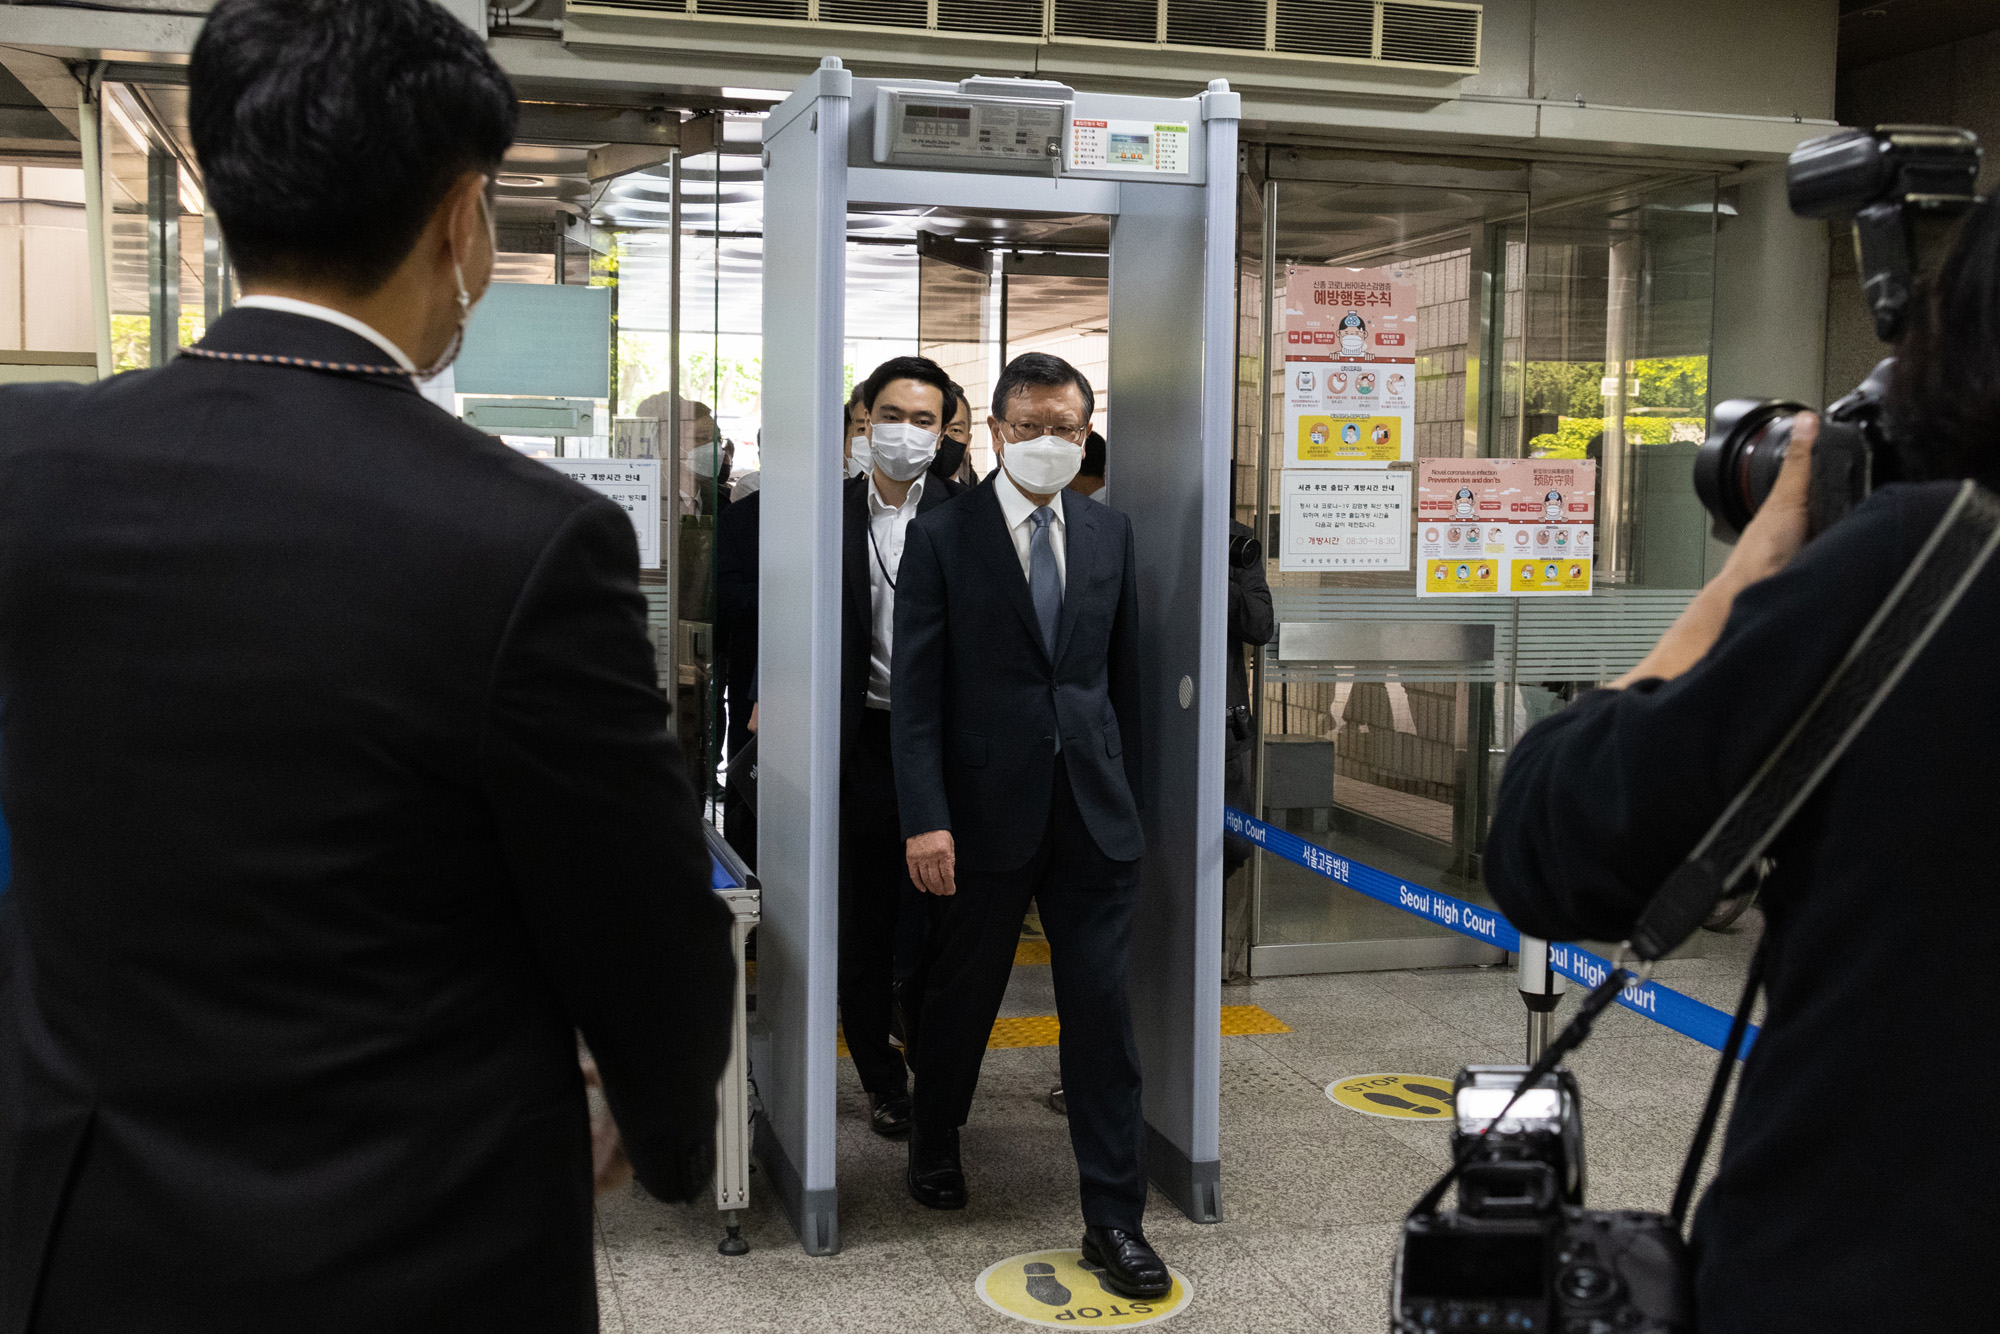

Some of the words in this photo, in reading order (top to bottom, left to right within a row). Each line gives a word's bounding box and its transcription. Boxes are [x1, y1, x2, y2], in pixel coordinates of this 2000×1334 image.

[1313, 281, 1326, 290] 신종
[1328, 281, 1391, 291] 코로나바이러스감염증
[1314, 290, 1392, 307] 예방행동수칙
[565, 473, 586, 482] 입구
[590, 473, 621, 482] 개방시간
[625, 474, 641, 482] 안내
[1534, 474, 1574, 486] 预防守则
[1298, 484, 1311, 492] 서관
[1314, 484, 1327, 492] 후면
[1331, 484, 1350, 492] 출입구
[1353, 484, 1379, 492] 개방시간
[1308, 536, 1340, 546] 개방시간
[1226, 810, 1243, 833] High
[1245, 819, 1266, 843] Court
[1302, 845, 1349, 883] 서울고등법원
[1400, 885, 1430, 914] Seoul
[1433, 897, 1459, 925] High
[1463, 907, 1497, 938] Court
[1573, 952, 1606, 987] High
[1616, 980, 1656, 1013] ourt
[1343, 1076, 1399, 1093] STOP
[1055, 1302, 1154, 1321] STOP
